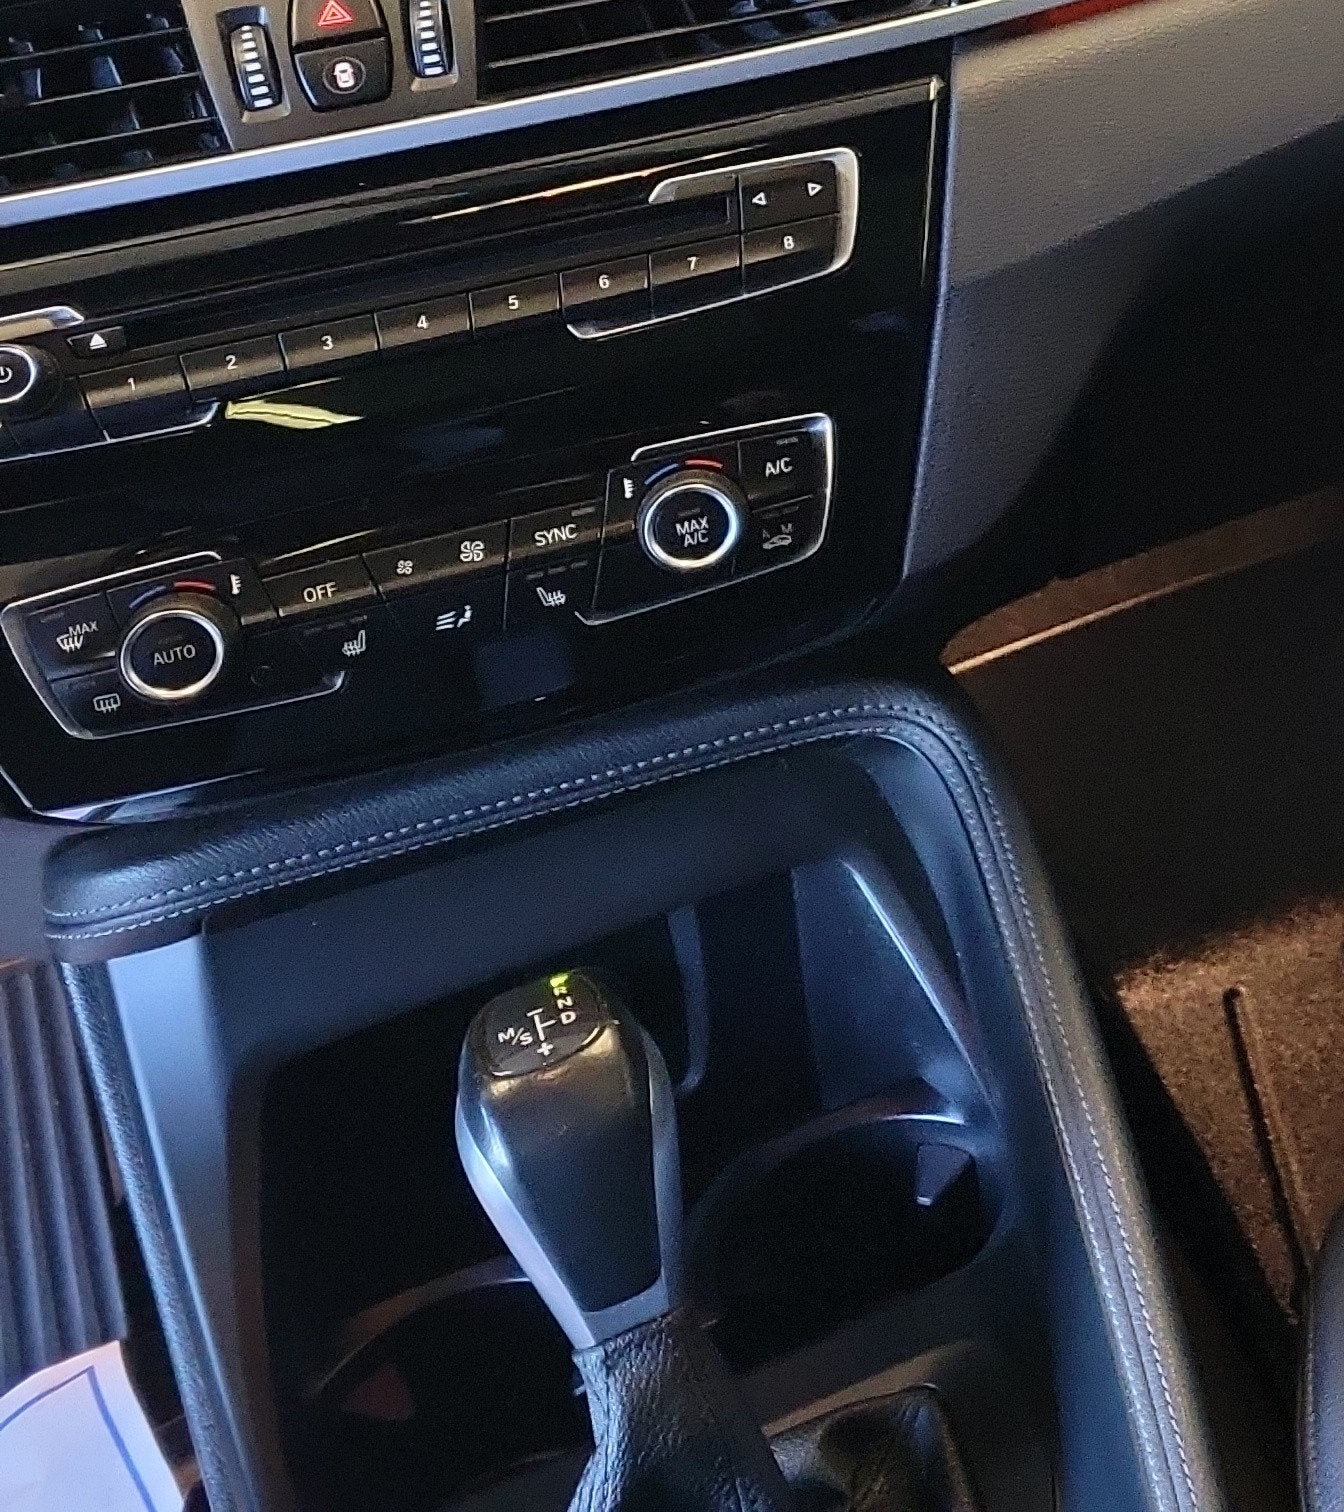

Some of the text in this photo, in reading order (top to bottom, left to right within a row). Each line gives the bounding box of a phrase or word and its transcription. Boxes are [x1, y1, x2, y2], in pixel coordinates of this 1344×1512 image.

[783, 235, 795, 250] 8
[687, 256, 698, 271] 7
[599, 274, 610, 289] 6
[508, 295, 519, 310] 5
[416, 314, 430, 330] 4
[321, 334, 334, 351] 3
[225, 354, 238, 370] 2
[127, 377, 136, 391] 1
[765, 457, 793, 477] A/C
[675, 516, 709, 537] MAX
[534, 523, 578, 548] SYNC
[683, 530, 709, 548] A/C
[303, 581, 338, 603] OFF
[68, 620, 99, 637] MAX
[153, 644, 196, 666] AUTO
[556, 995, 573, 1010] N
[560, 1011, 576, 1025] D
[498, 1027, 533, 1046] M/S
